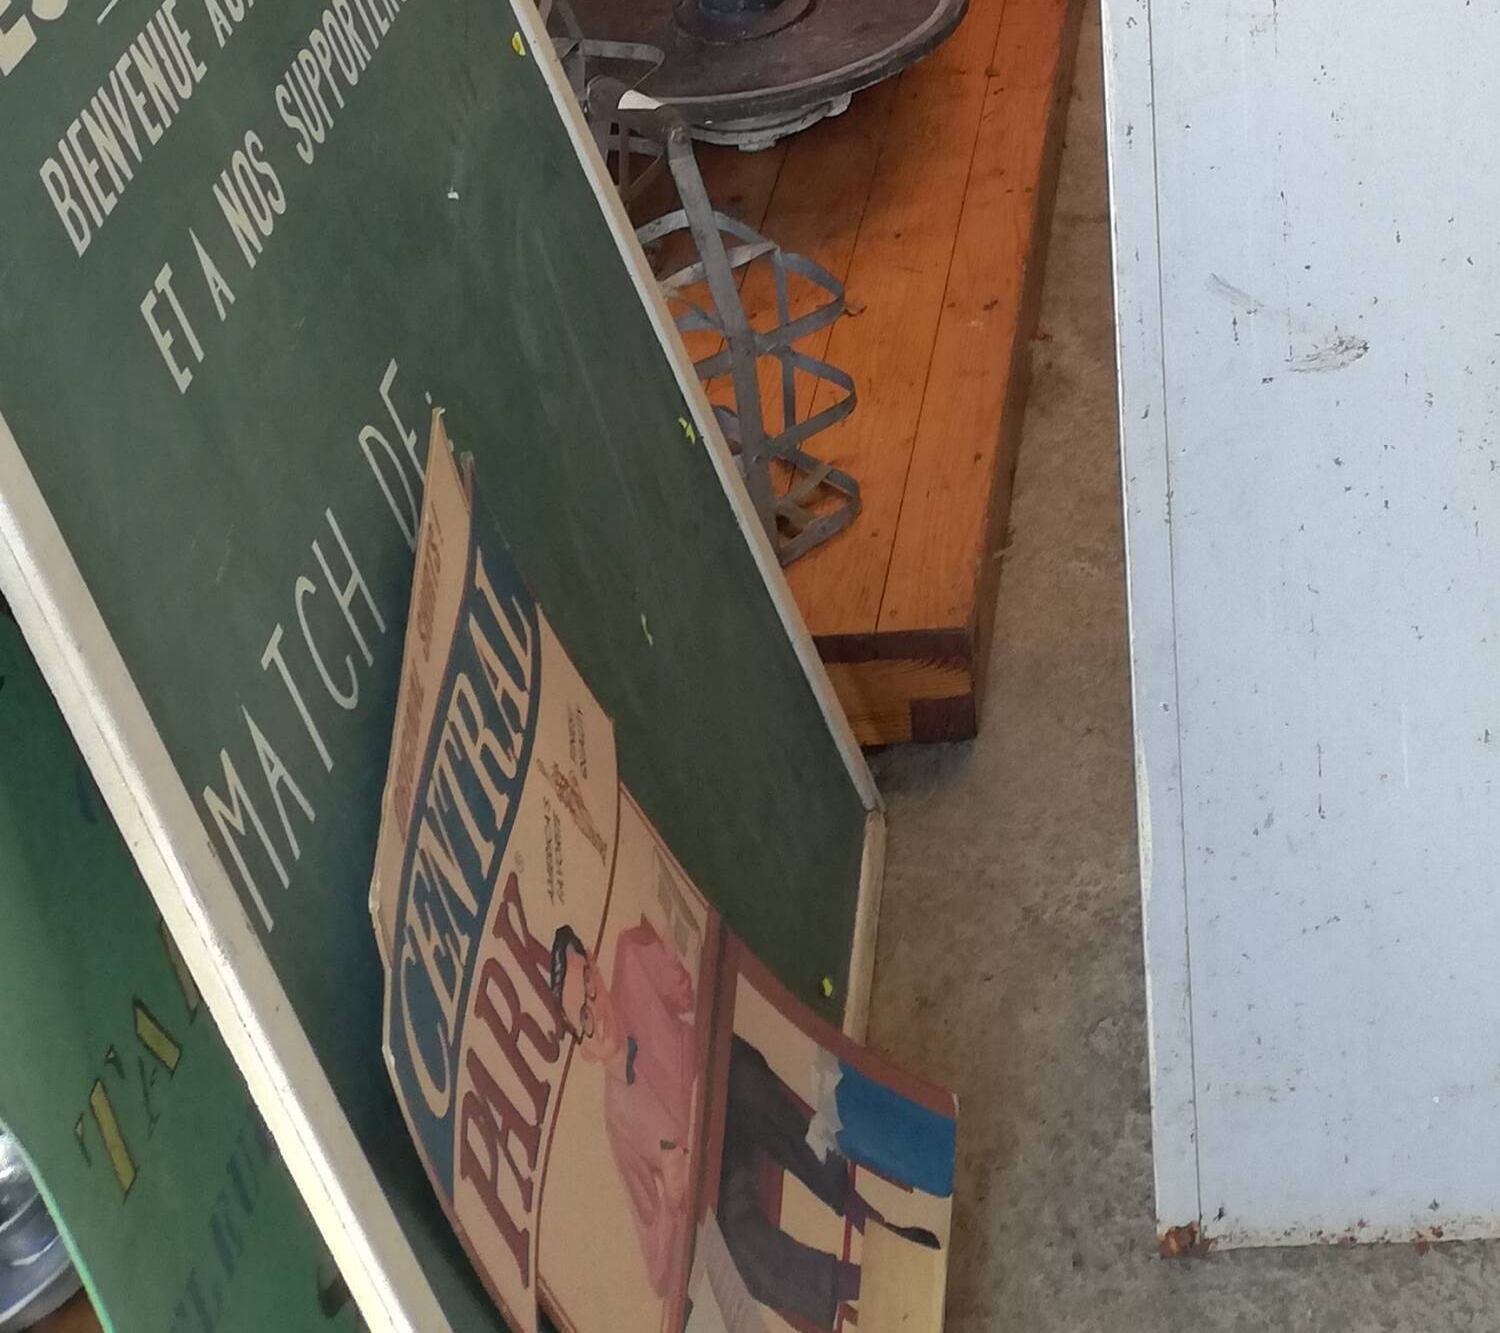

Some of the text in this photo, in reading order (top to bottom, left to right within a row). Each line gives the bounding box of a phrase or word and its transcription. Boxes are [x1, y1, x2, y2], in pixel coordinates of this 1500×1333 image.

[140, 262, 205, 394] ET
[212, 130, 289, 270] NOS
[203, 509, 397, 933] MATCH
[401, 545, 534, 1119] CENTRAL
[460, 871, 562, 1289] PARK
